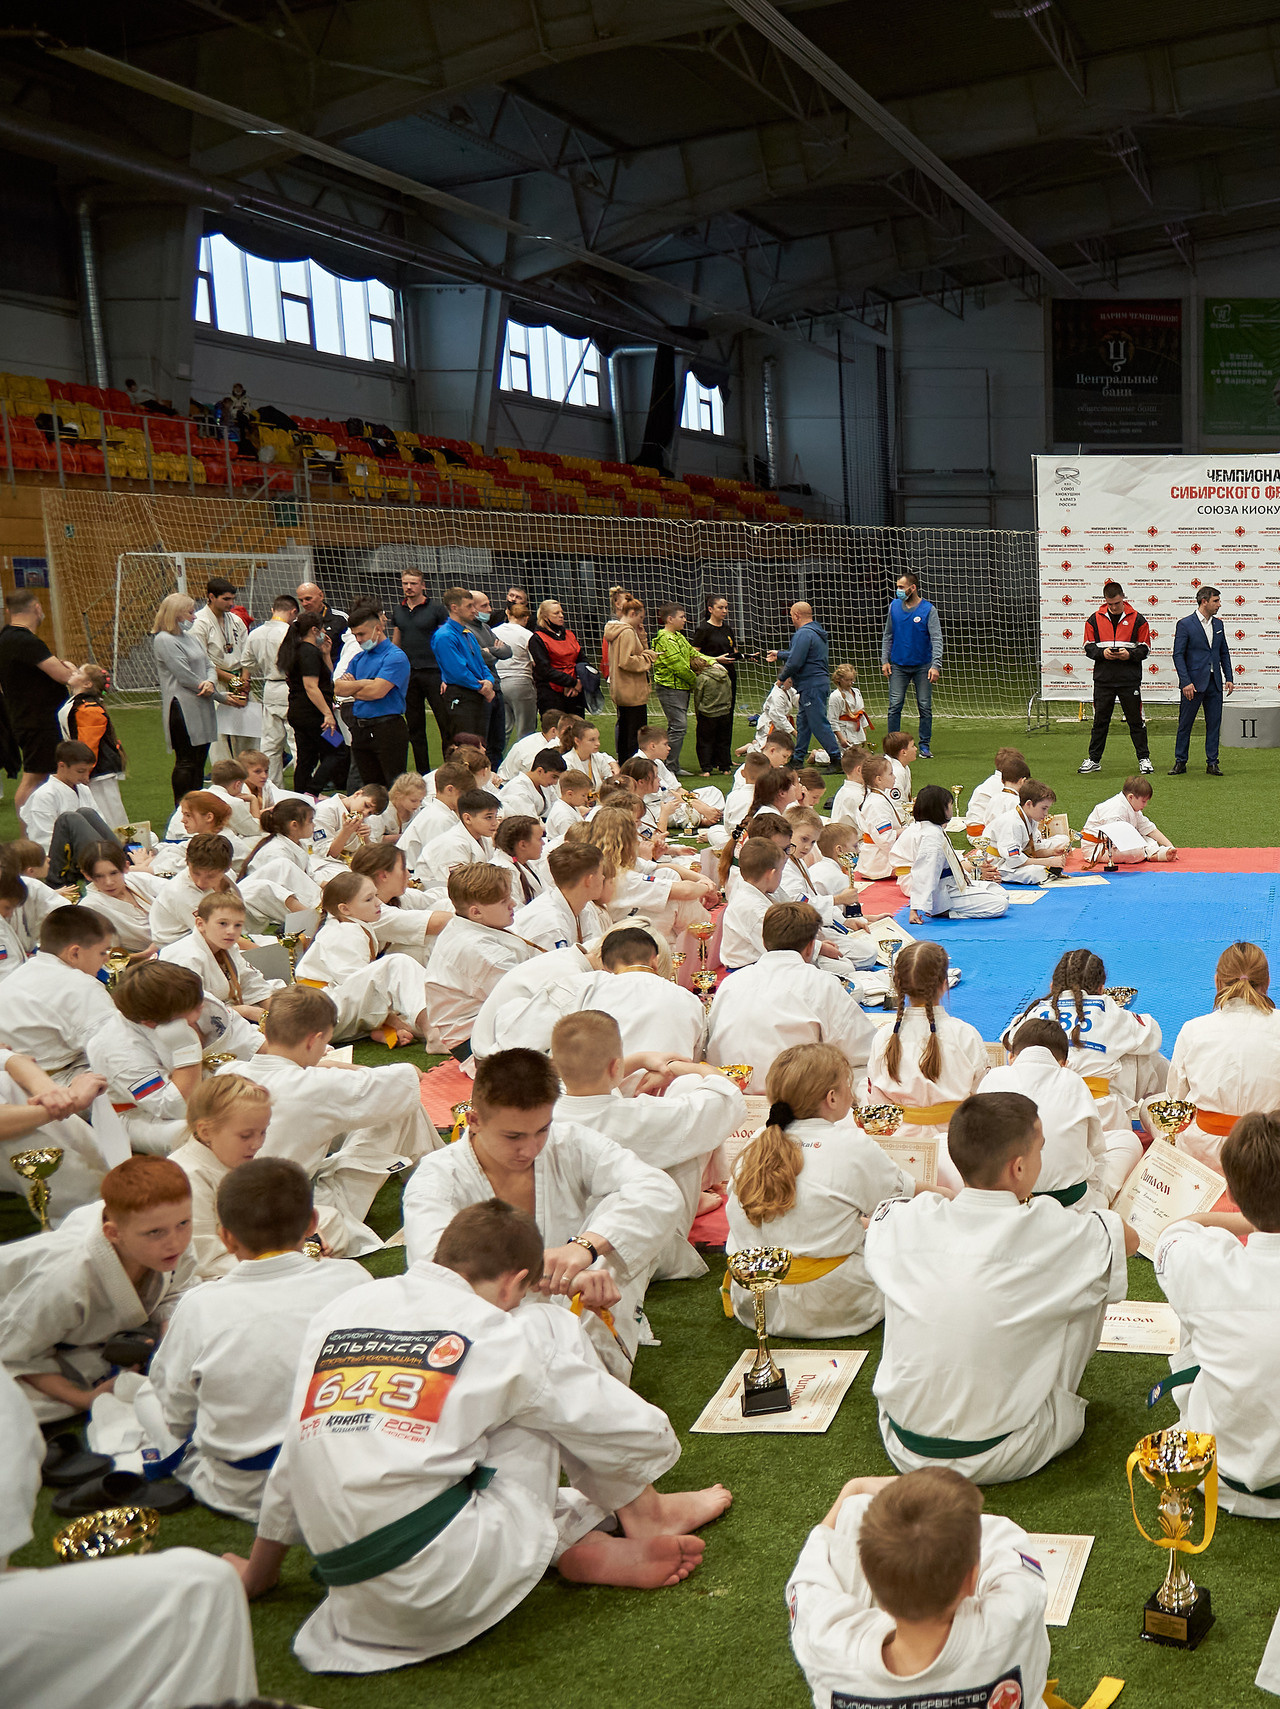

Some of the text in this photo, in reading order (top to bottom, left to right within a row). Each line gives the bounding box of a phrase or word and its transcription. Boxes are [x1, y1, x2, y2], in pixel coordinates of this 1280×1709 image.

[1075, 373, 1160, 387] Центральные
[1102, 386, 1134, 397] бани
[1171, 486, 1260, 499] СИБИРСКОГО
[1197, 505, 1239, 515] СОЮЗА
[1240, 719, 1258, 739] II
[1104, 1315, 1154, 1323] иплом
[328, 1332, 374, 1342] ЧЕМПИОНАТ
[384, 1333, 439, 1343] ПЕРВЕНСТВО
[321, 1341, 429, 1357] АЛЬЯНСА
[319, 1354, 365, 1367] ОТКРЫТЫЙ
[313, 1370, 427, 1411] 643
[325, 1413, 377, 1427] KARATE
[384, 1418, 432, 1436] 2021
[912, 1692, 988, 1709] ПЕРВЕНСТВО
